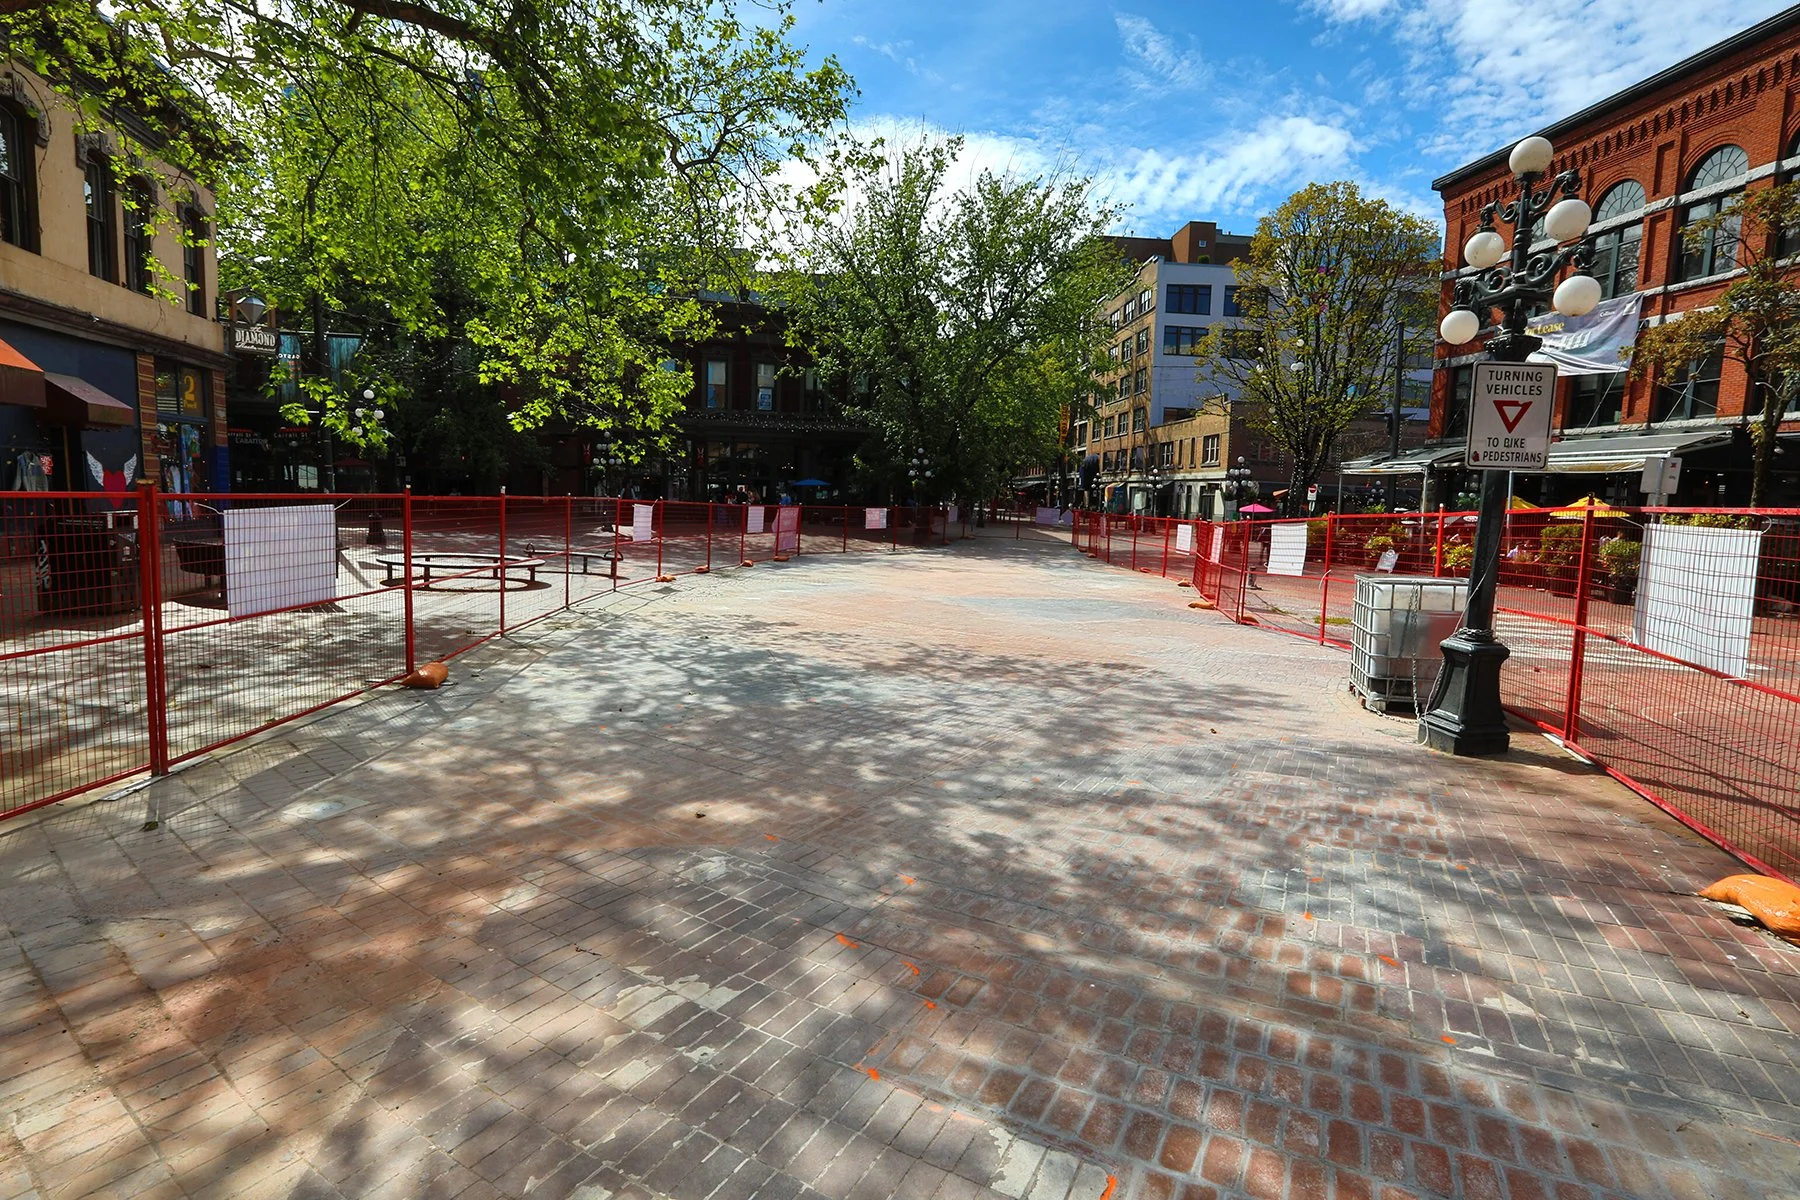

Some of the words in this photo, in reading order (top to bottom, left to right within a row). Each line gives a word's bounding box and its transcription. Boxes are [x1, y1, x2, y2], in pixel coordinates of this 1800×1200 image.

[1537, 321, 1565, 335] Lease
[235, 329, 275, 347] DIAMOND
[1488, 370, 1543, 382] TURNING
[183, 375, 196, 401] 2
[1486, 384, 1543, 396] VEHICLES
[1487, 437, 1499, 448] TO
[1503, 437, 1525, 449] BIKE
[1482, 451, 1542, 463] PEDESTRIANS
